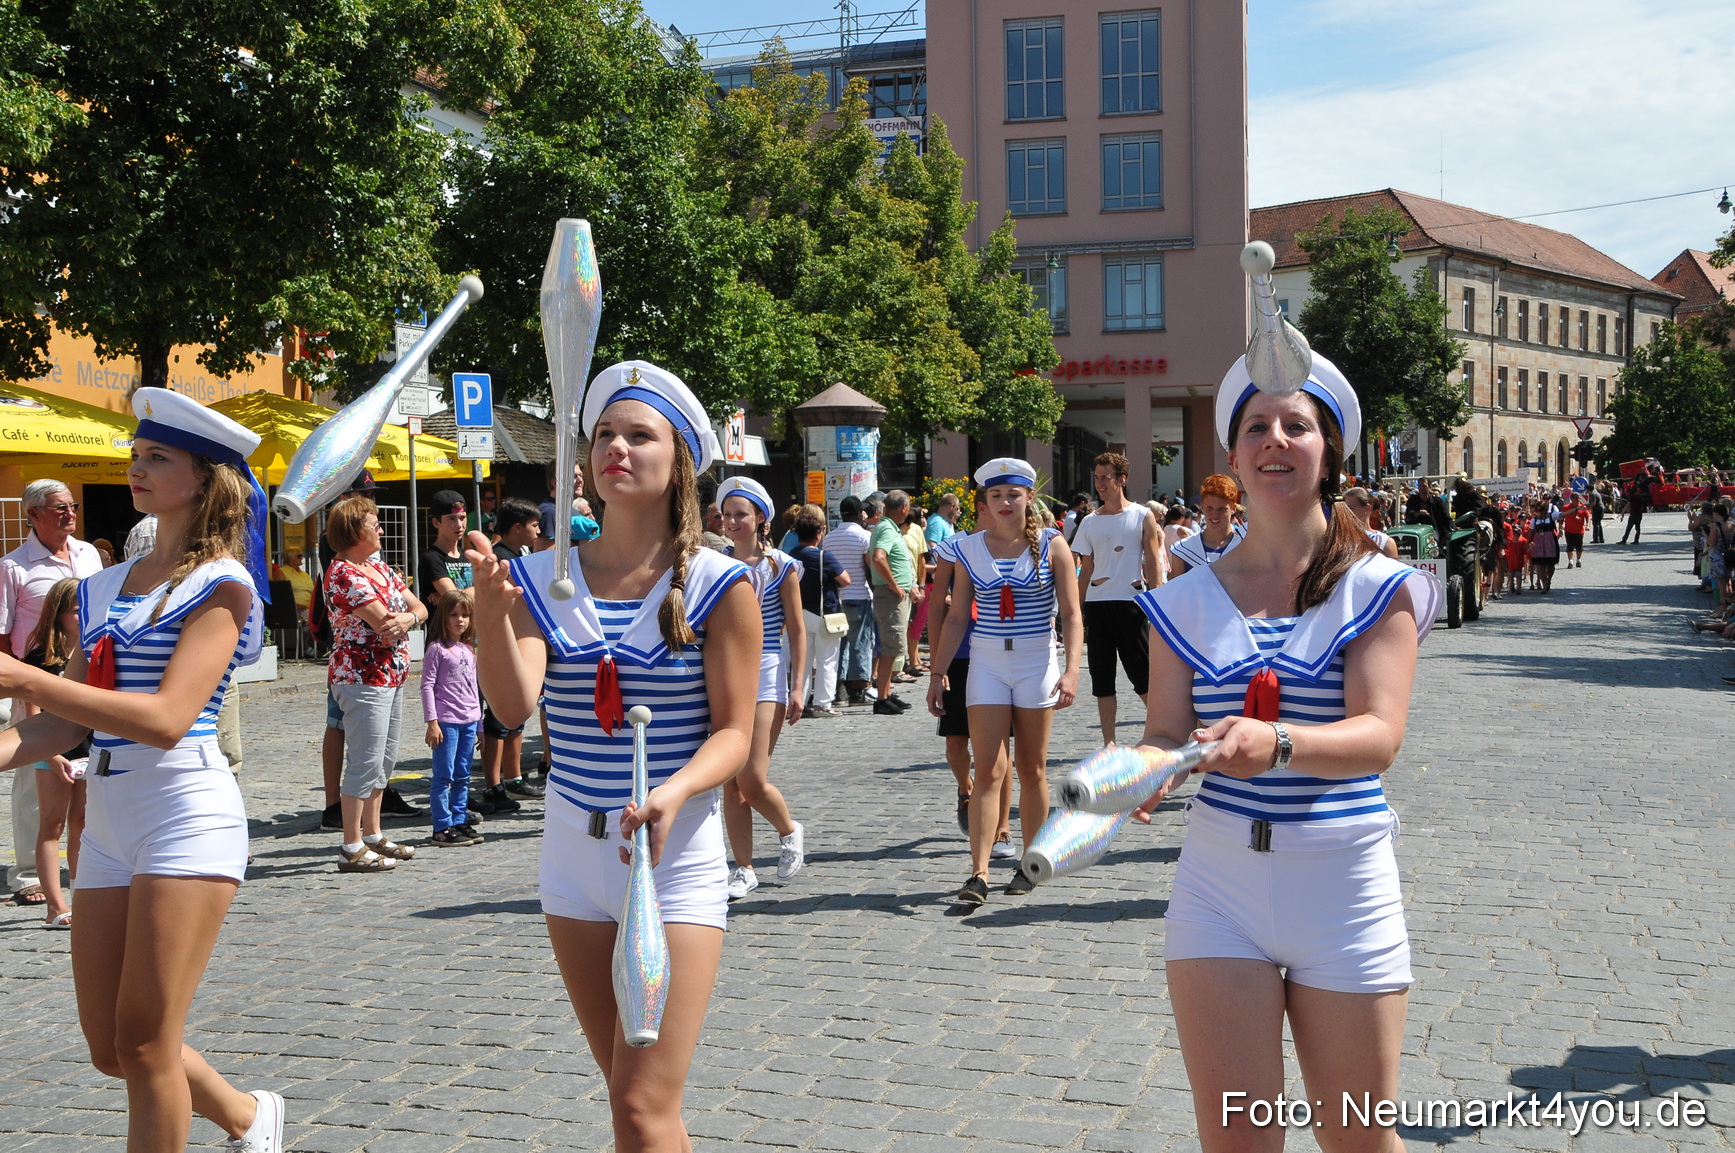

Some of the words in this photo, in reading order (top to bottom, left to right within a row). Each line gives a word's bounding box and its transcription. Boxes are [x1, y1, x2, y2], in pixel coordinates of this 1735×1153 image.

[865, 119, 920, 132] HÖFFMANN
[1052, 354, 1168, 381] Sparkasse
[462, 381, 483, 420] P
[2, 428, 30, 441] Café
[45, 430, 105, 446] Konditorei
[731, 425, 740, 446] M
[394, 451, 431, 464] Kontorei
